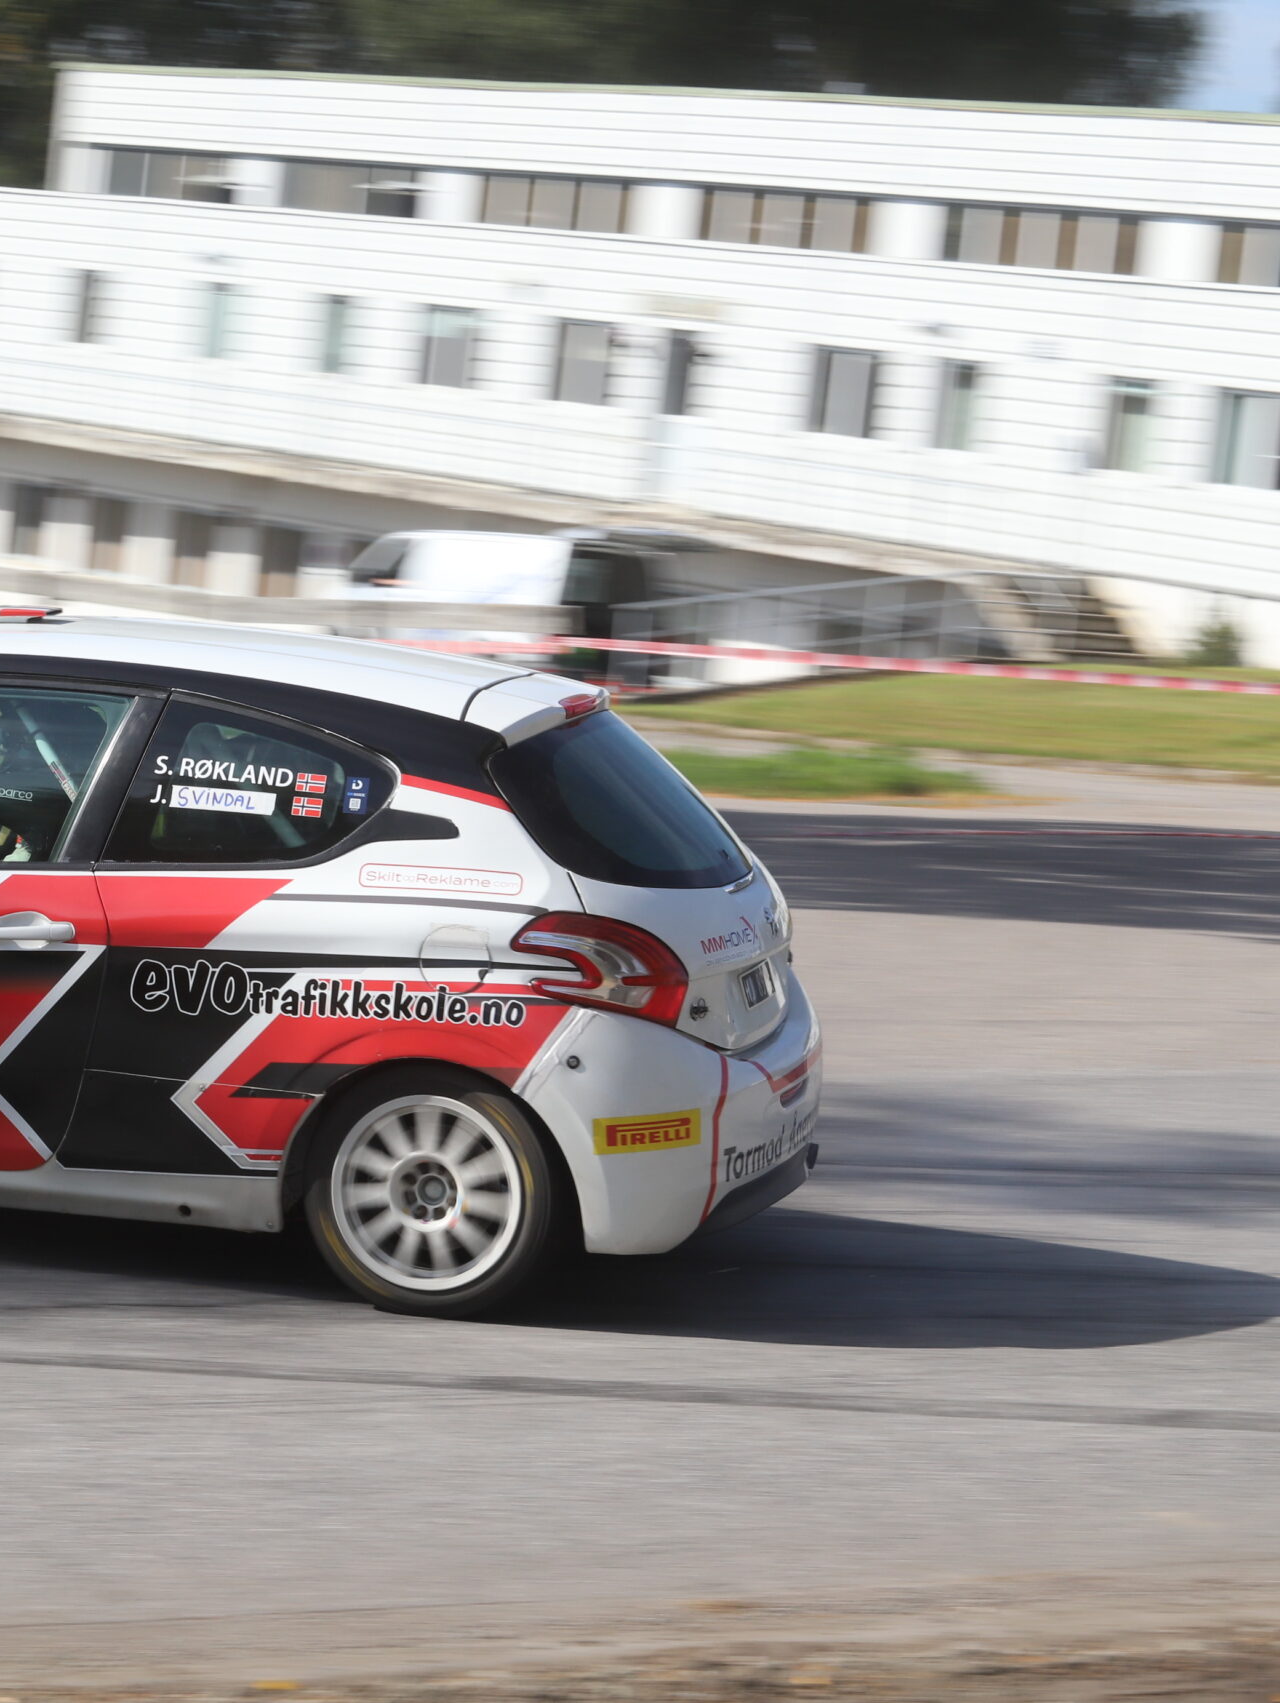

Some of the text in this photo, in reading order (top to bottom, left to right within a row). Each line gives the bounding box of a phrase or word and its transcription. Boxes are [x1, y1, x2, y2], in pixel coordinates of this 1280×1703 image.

[154, 756, 294, 787] S. RØKLAND
[149, 784, 167, 804] J.
[606, 1117, 692, 1147] PIRELLI
[723, 1124, 785, 1182] Tormod
